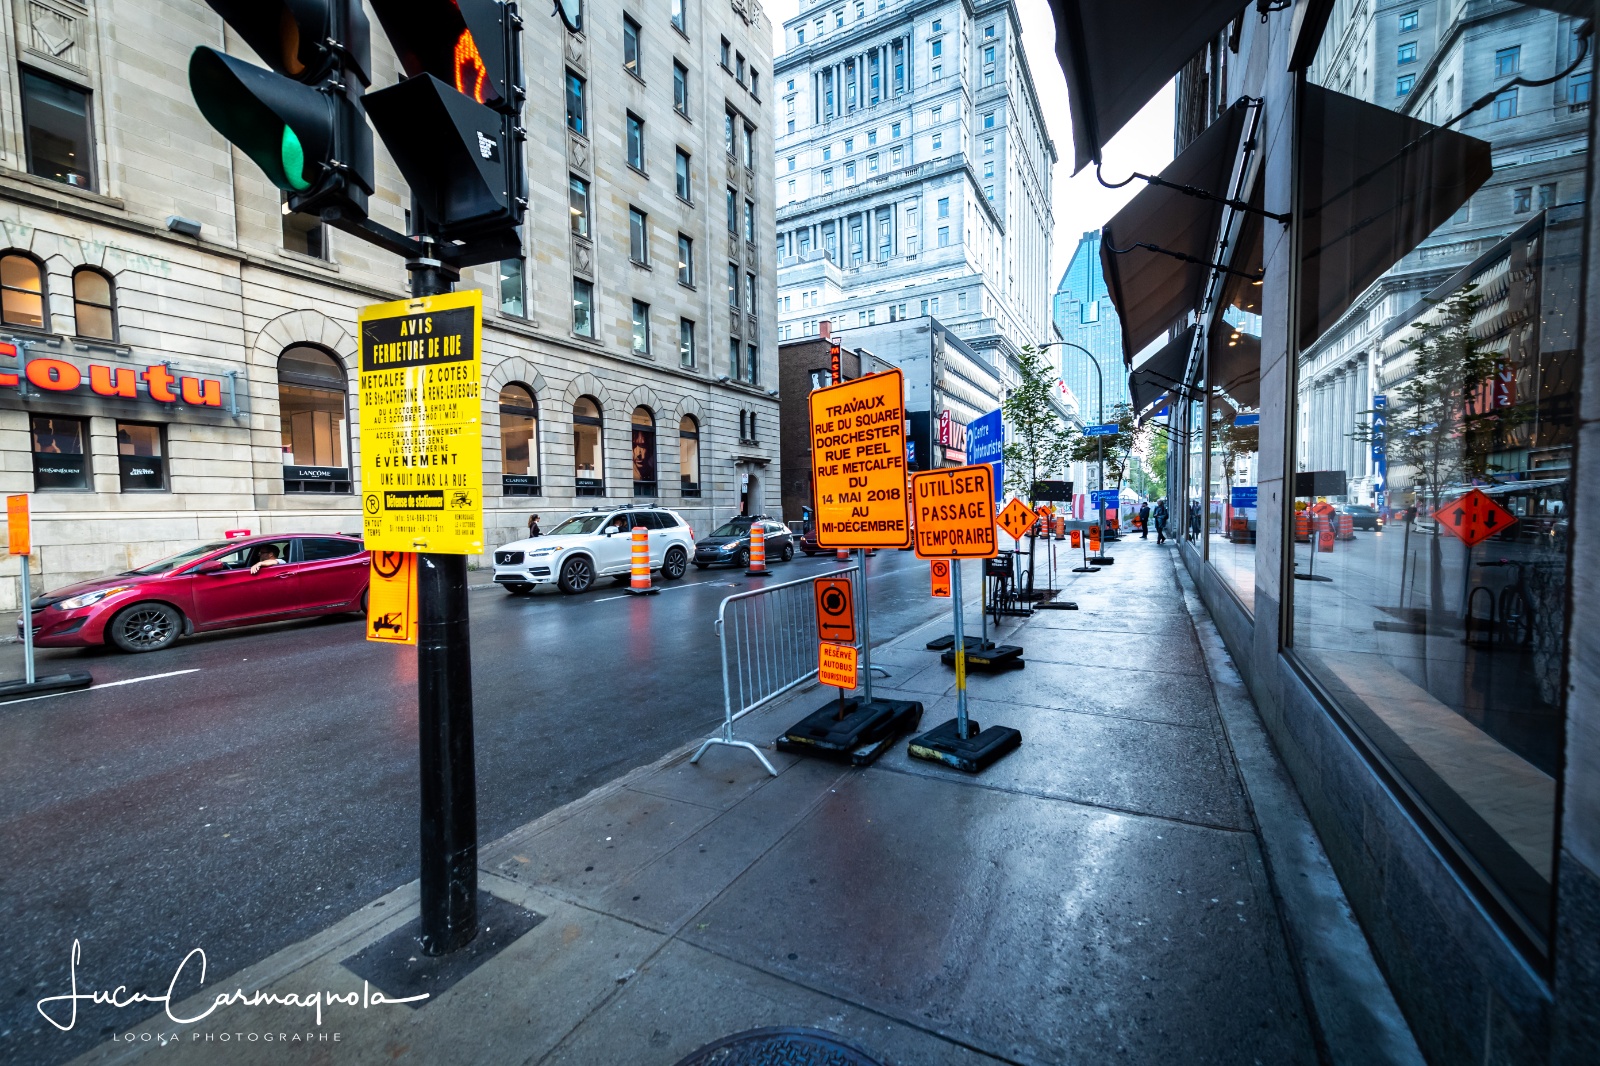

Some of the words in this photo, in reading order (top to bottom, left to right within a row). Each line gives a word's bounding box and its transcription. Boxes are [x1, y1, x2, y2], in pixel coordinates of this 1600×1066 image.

[400, 317, 433, 337] AVIS
[373, 339, 424, 364] FERMETURE
[428, 337, 440, 358] DE
[443, 335, 461, 356] RUE
[361, 372, 405, 389] METCALFE
[428, 368, 434, 383] 2
[365, 391, 373, 406] DE
[379, 408, 387, 416] DU
[395, 405, 422, 415] OCTOBRE
[448, 403, 457, 411] AM
[826, 395, 885, 418] TRAVAUX
[374, 416, 382, 424] AU
[389, 414, 416, 423] OCTOBRE
[815, 420, 834, 435] RUE
[837, 417, 852, 431] DU
[855, 408, 900, 428] SQUARE
[396, 430, 408, 438] AUX
[411, 427, 462, 437] STATIONNEMENT
[941, 411, 949, 444] AVIS
[974, 424, 989, 439] Centre
[402, 437, 444, 446] DOUBLE-SENS
[816, 424, 900, 449] DORCHESTER
[401, 444, 449, 454] STE-CATHERINE
[825, 447, 852, 462] RUE
[856, 442, 891, 457] PEEL
[375, 453, 458, 468] ÉVENEMENT
[818, 464, 839, 477] RUE
[842, 456, 902, 474] METCALFE
[380, 473, 394, 485] UNE
[397, 473, 413, 485] NUIT
[417, 473, 436, 486] DANS
[439, 474, 449, 486] LA
[453, 474, 467, 486] RUE
[849, 476, 868, 488] DU
[919, 475, 985, 498] UTILISER
[386, 494, 408, 508] Défense
[408, 494, 415, 508] de
[415, 494, 443, 508] stationner
[822, 494, 834, 505] 14
[838, 491, 862, 504] MAI
[867, 488, 901, 502] 2018
[851, 506, 869, 518] AU
[922, 501, 986, 522] PASSAGE
[919, 527, 992, 547] TEMPORAIRE
[824, 647, 852, 660] RÉSERVÉ
[823, 660, 852, 672] AUTOBUS
[821, 671, 854, 684] TOURISTIQUE
